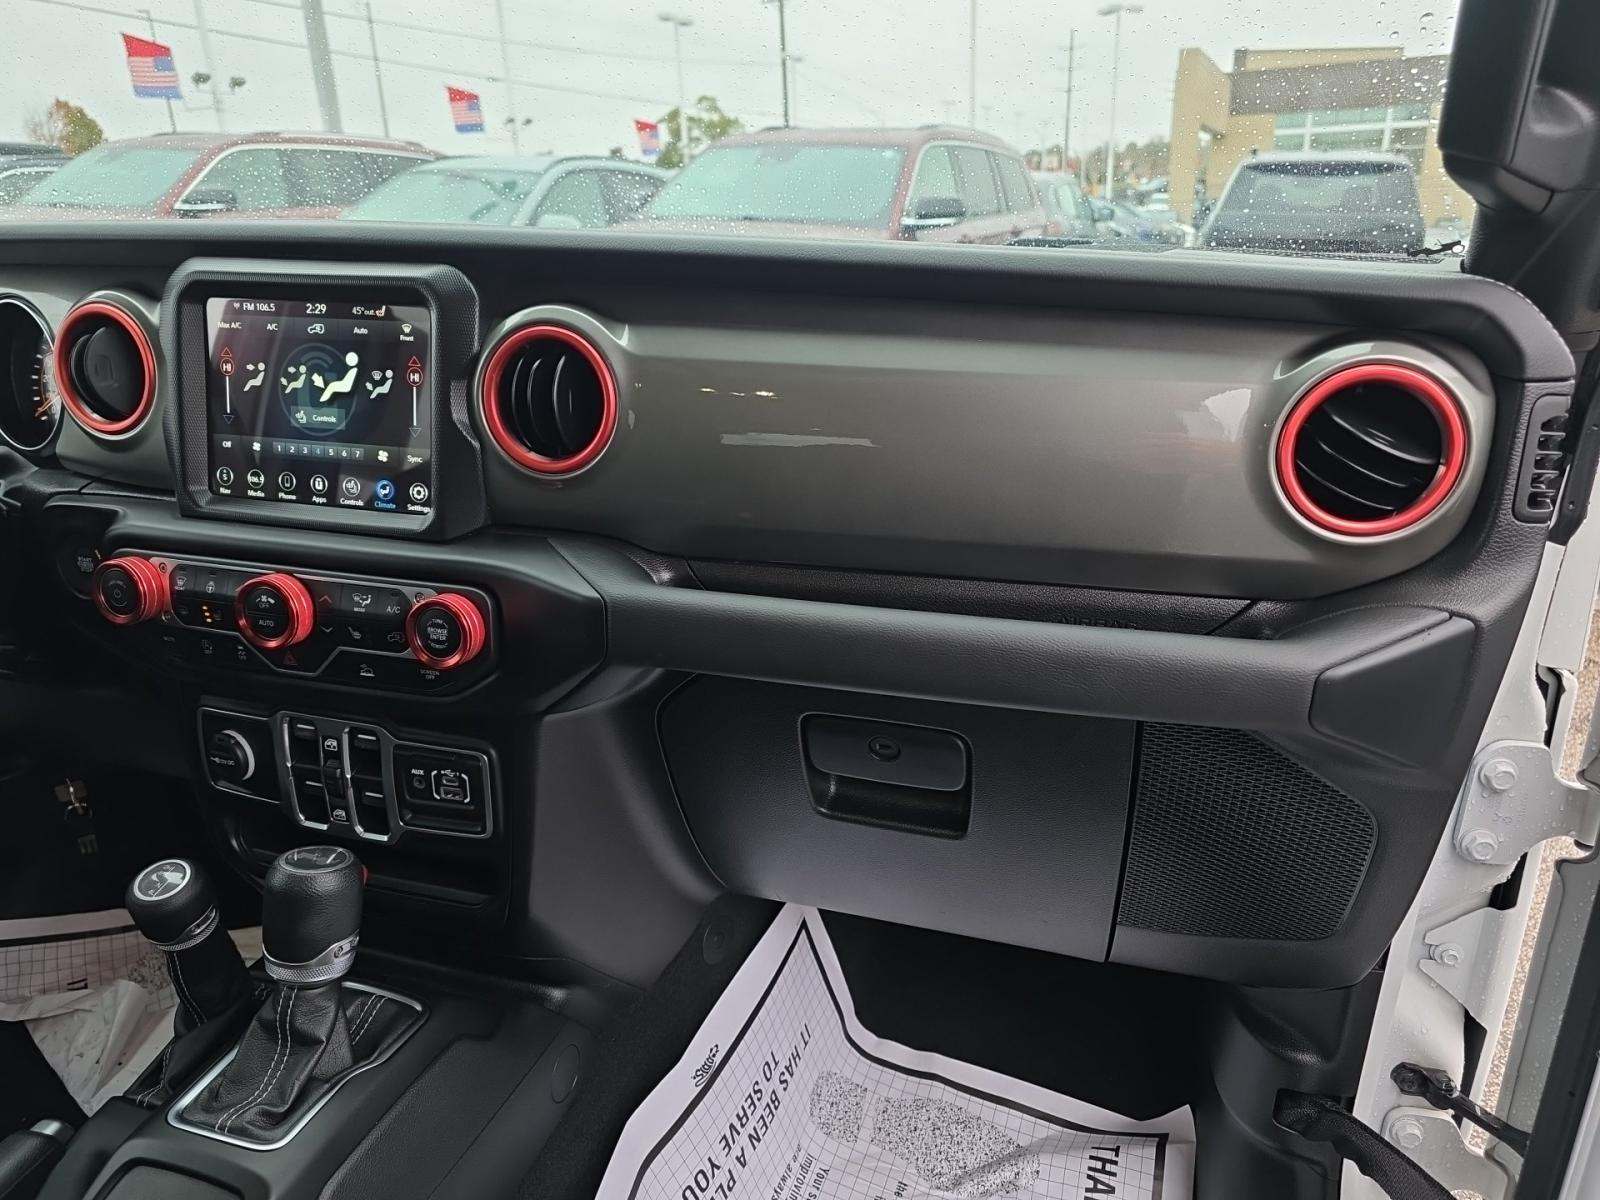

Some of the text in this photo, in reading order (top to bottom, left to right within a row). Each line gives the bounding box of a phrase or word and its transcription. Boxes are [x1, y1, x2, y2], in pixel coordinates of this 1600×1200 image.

[243, 302, 276, 312] FM 106.5
[306, 303, 327, 314] 2:29
[230, 321, 242, 329] A/C
[266, 323, 279, 331] A/C
[353, 326, 369, 335] Auto
[312, 414, 337, 423] Controls
[407, 454, 423, 464] Sync
[247, 489, 265, 498] Media
[278, 492, 297, 500] Phone
[312, 495, 327, 504] Apps
[340, 498, 364, 507] Controls
[374, 500, 396, 509] Climate
[407, 503, 432, 514] Settings
[386, 604, 401, 614] A/C
[259, 619, 274, 627] AUTO
[411, 768, 425, 776] AUX
[800, 1022, 812, 1050] IT
[778, 1045, 802, 1092] HAS
[747, 1088, 781, 1151] BEEN
[682, 1051, 780, 1200] TO SERVE YOU
[735, 1146, 748, 1169] A
[786, 1152, 818, 1200] improvin
[1083, 1145, 1121, 1200] THA
[812, 1167, 830, 1192] Your
